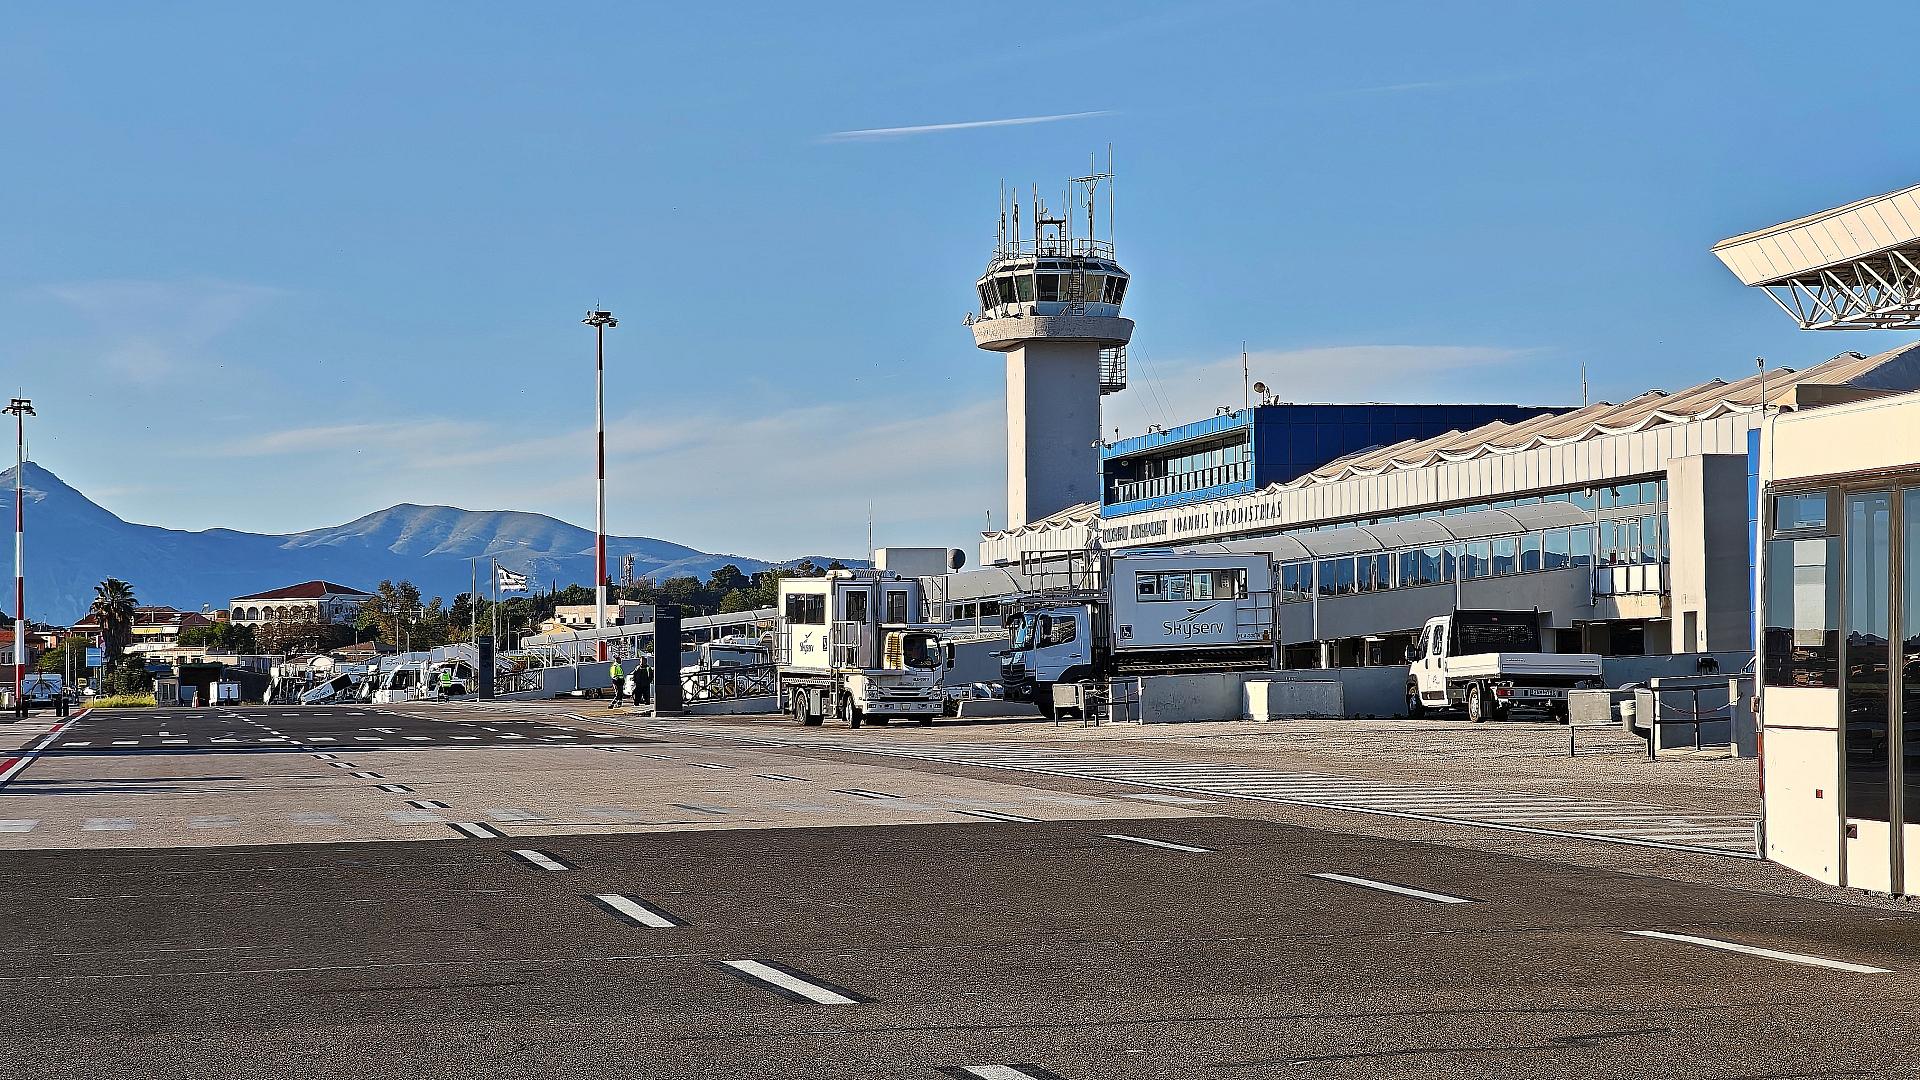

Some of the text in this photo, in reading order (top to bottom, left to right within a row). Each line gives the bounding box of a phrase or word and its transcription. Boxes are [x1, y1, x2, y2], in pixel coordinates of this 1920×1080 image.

[1173, 512, 1209, 533] IOANNIS
[1214, 500, 1282, 527] KAPODISTRIAS
[1163, 620, 1224, 640] Skyserv
